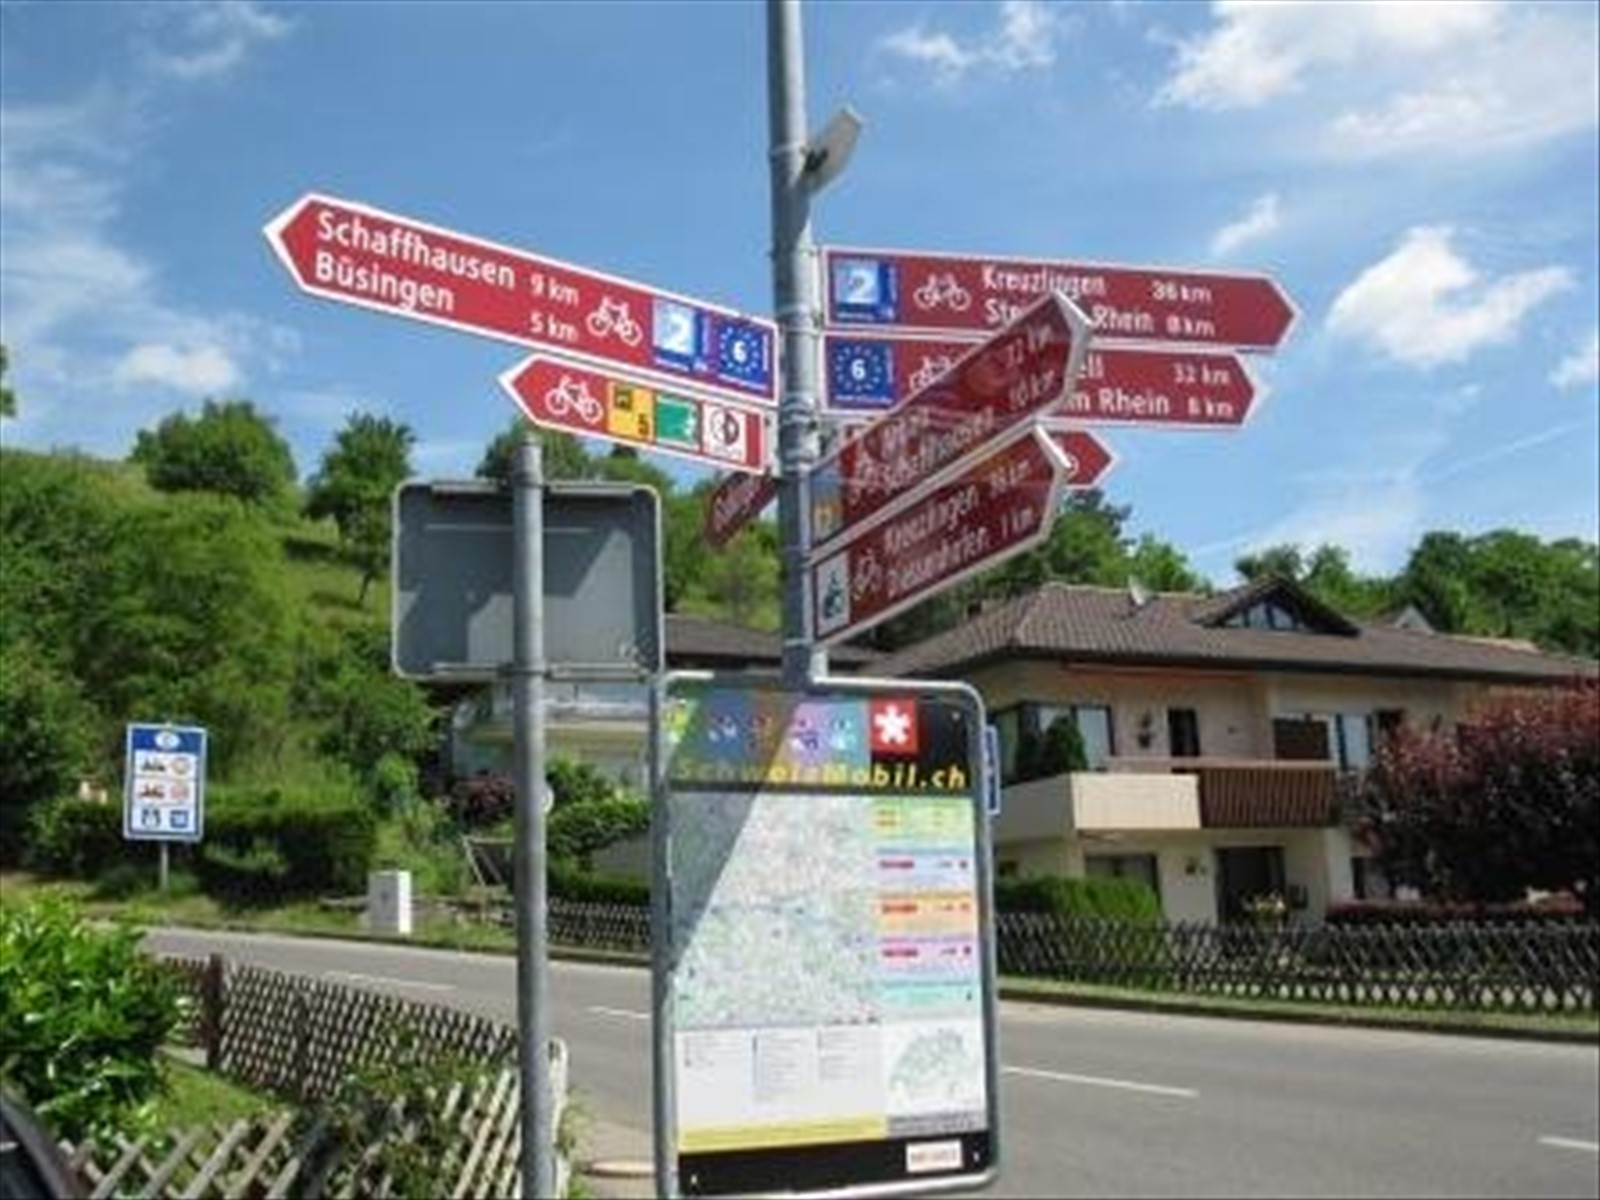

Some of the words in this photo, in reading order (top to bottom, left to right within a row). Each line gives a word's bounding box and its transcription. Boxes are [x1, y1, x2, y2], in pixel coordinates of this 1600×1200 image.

[317, 209, 516, 290] Schaffhausen
[530, 272, 544, 297] 9
[548, 276, 580, 307] km
[314, 251, 455, 314] Büsingen
[530, 309, 544, 335] 5
[548, 313, 580, 343] km
[847, 269, 876, 303] 2
[981, 265, 1107, 300] Kreuzlingen
[1180, 284, 1213, 304] km
[663, 309, 693, 355] 2
[1091, 304, 1155, 333] Rhein
[1183, 316, 1216, 338] km
[732, 339, 748, 364] 6
[851, 359, 867, 381] 6
[1201, 361, 1232, 385] km
[1098, 386, 1170, 416] Rhein
[1203, 396, 1235, 418] km
